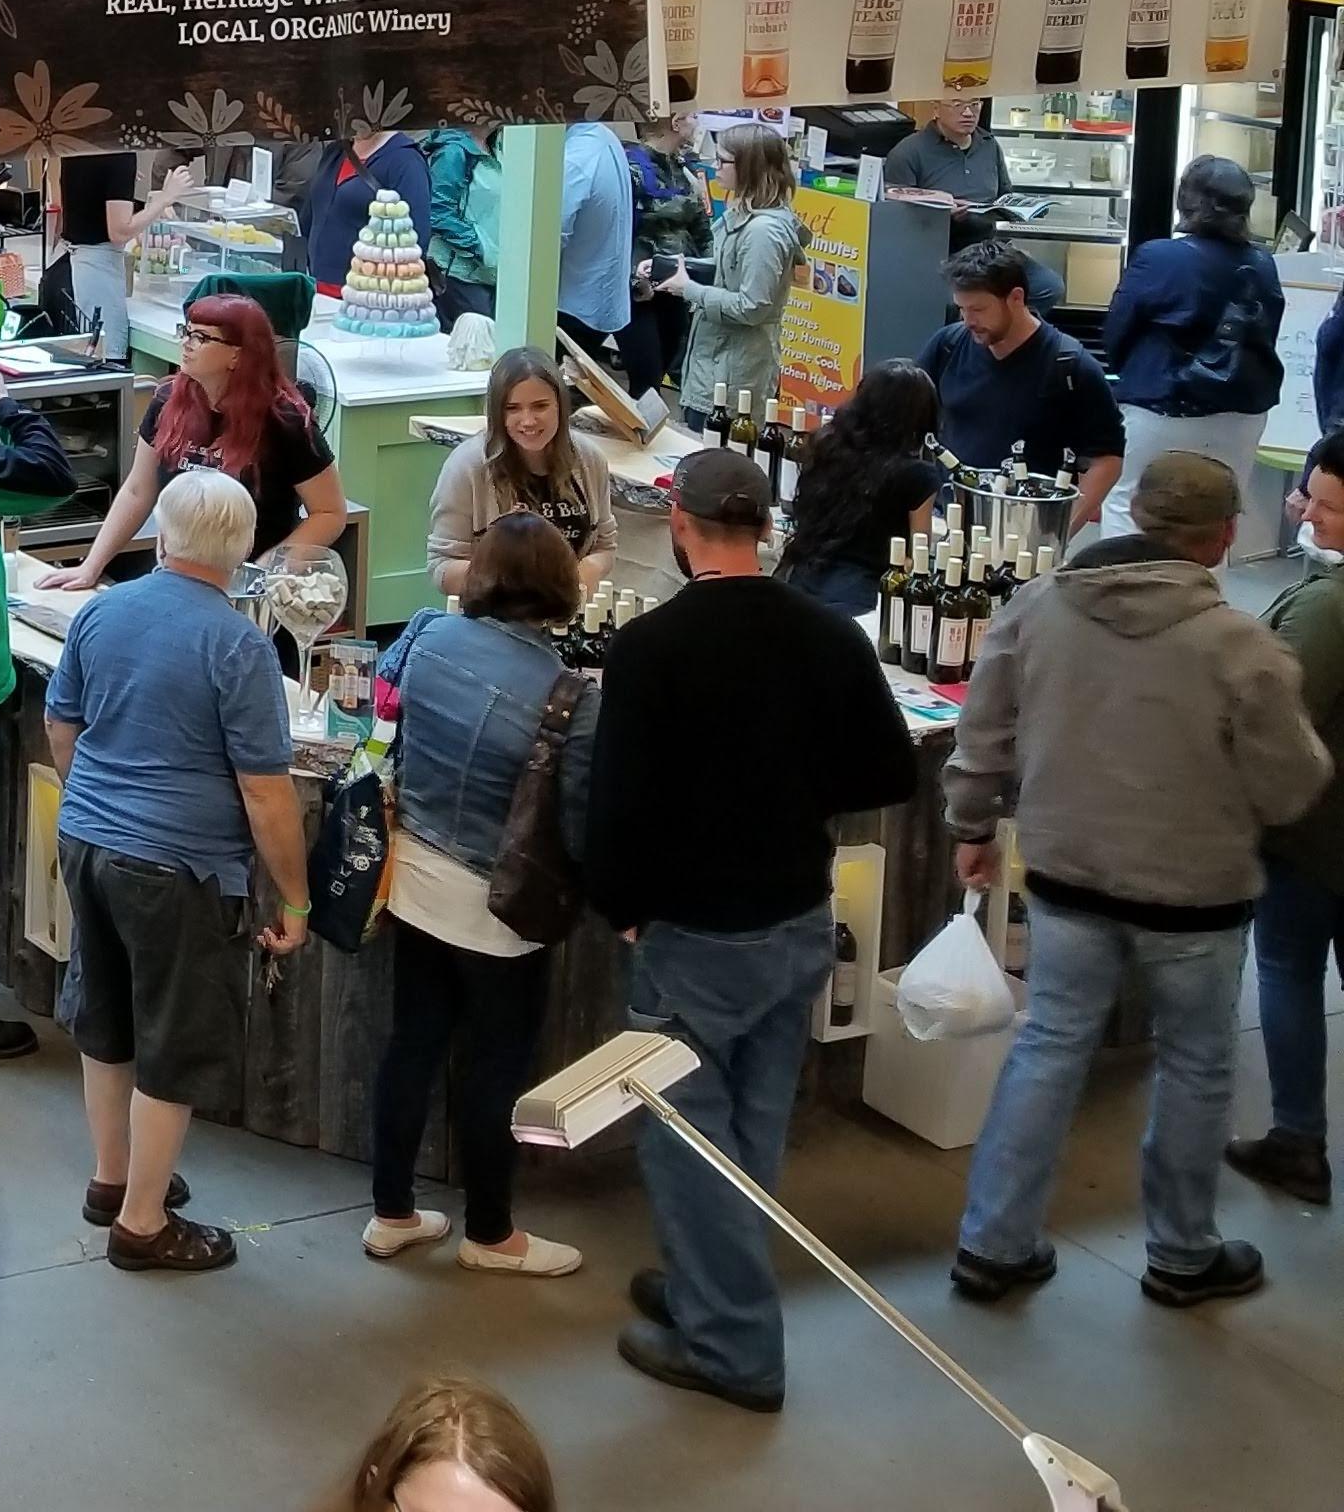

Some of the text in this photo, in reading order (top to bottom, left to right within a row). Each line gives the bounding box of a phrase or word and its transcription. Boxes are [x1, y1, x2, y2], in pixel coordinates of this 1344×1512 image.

[957, 2, 995, 16] HARD
[178, 8, 452, 46] LOCAL ORGANIC Winery
[956, 14, 994, 28] CORE
[781, 311, 820, 332] entures
[781, 328, 842, 355] ng, Hunting
[814, 354, 841, 372] Cook
[809, 371, 844, 393] Helper
